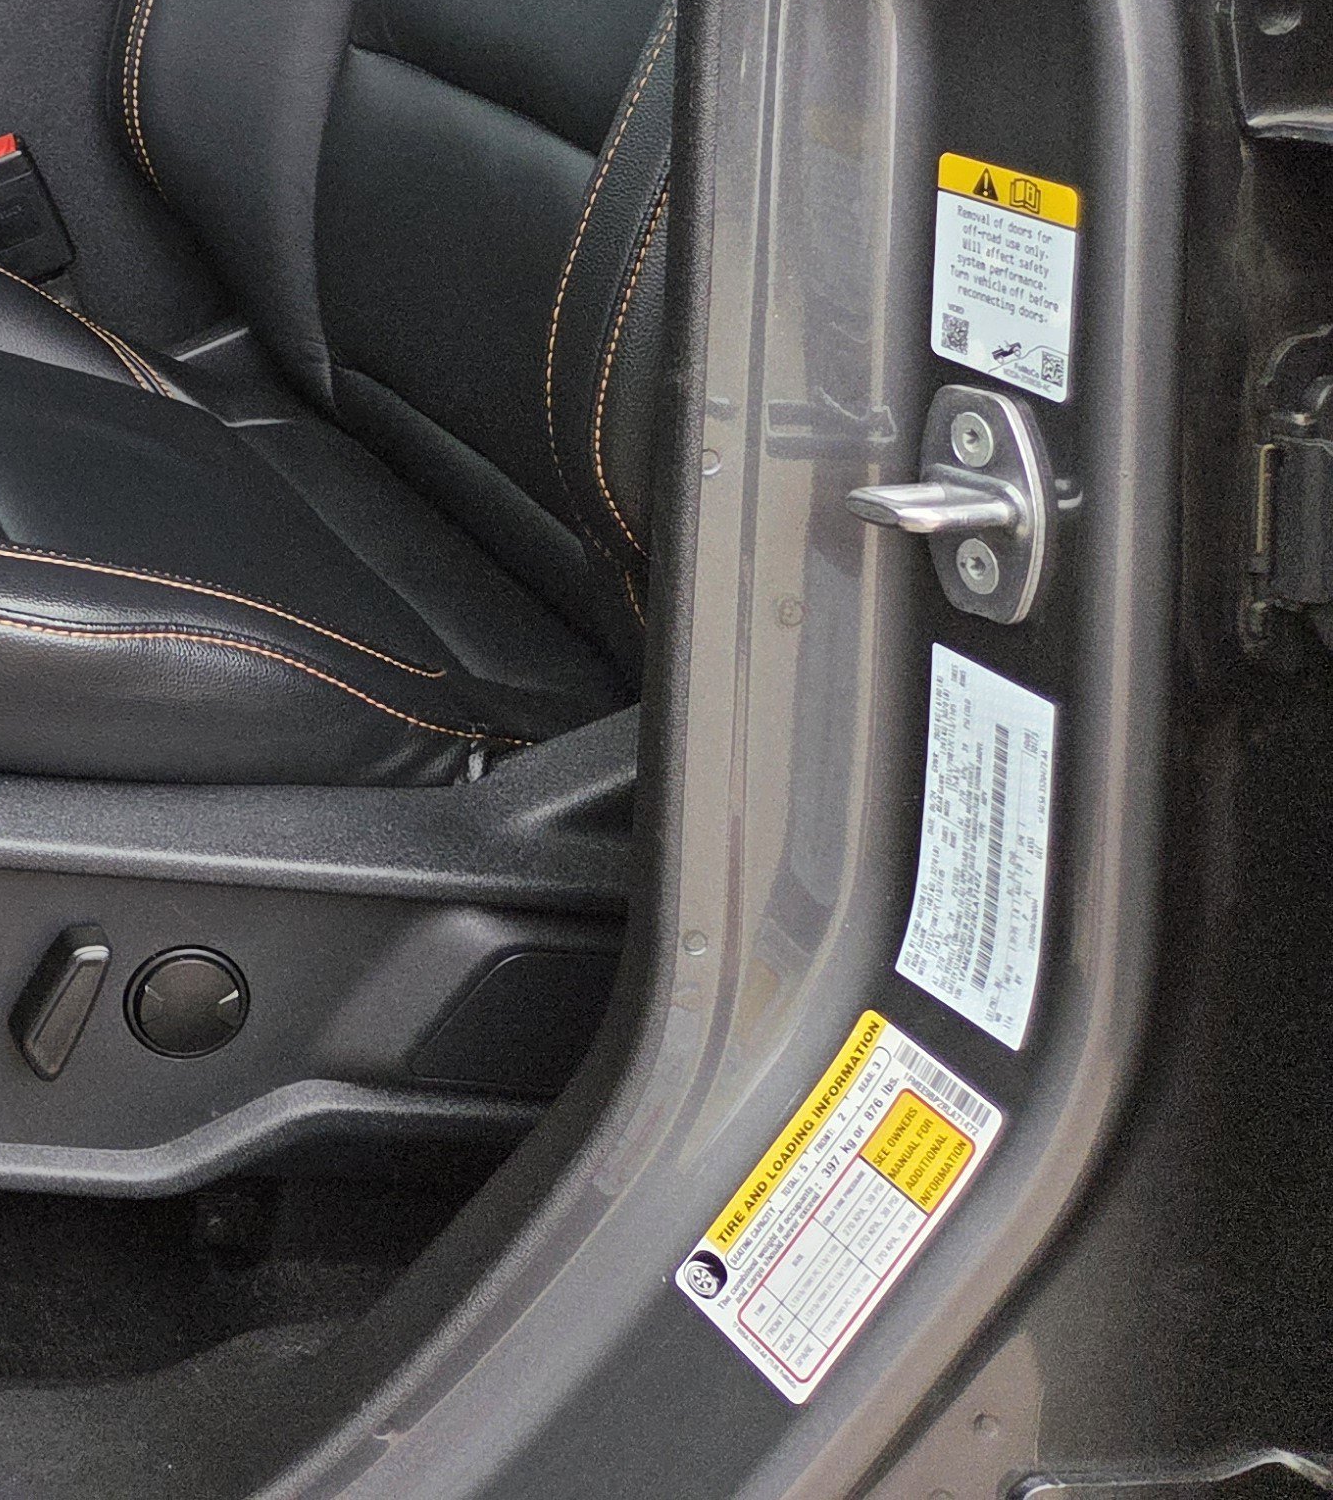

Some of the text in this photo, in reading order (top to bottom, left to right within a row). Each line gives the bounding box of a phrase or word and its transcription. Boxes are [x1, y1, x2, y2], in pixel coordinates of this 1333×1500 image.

[957, 205, 1052, 245] Removal of doors for
[962, 221, 1048, 263] off-road use only.
[957, 252, 1046, 293] system performance.
[962, 237, 1048, 279] Will affect safety
[950, 264, 1058, 312] Turn vehicle off before
[957, 283, 1047, 324] reconnecting doors.
[871, 1060, 882, 1070] 3
[716, 1018, 880, 1246] TIRE AND LOADING INFORMATION
[820, 1072, 900, 1179] 397 kg or 876 lbs.
[836, 1111, 846, 1122] 2
[872, 1105, 919, 1167] SEE OWNERS
[797, 1161, 808, 1173] 5
[887, 1116, 934, 1180] MANUAL FOR
[903, 1131, 949, 1191] ADDITIONAL
[916, 1138, 969, 1207] INFORMATION
[717, 1292, 731, 1310] The
[728, 1256, 759, 1296] combined
[755, 1231, 779, 1261] weight
[774, 1222, 785, 1234] of
[781, 1184, 814, 1226] occupants
[729, 1204, 777, 1266] SEATING CAPACITY
[734, 1286, 748, 1304] and
[746, 1265, 765, 1290] cargo
[761, 1238, 784, 1268] should
[781, 1218, 800, 1242] never
